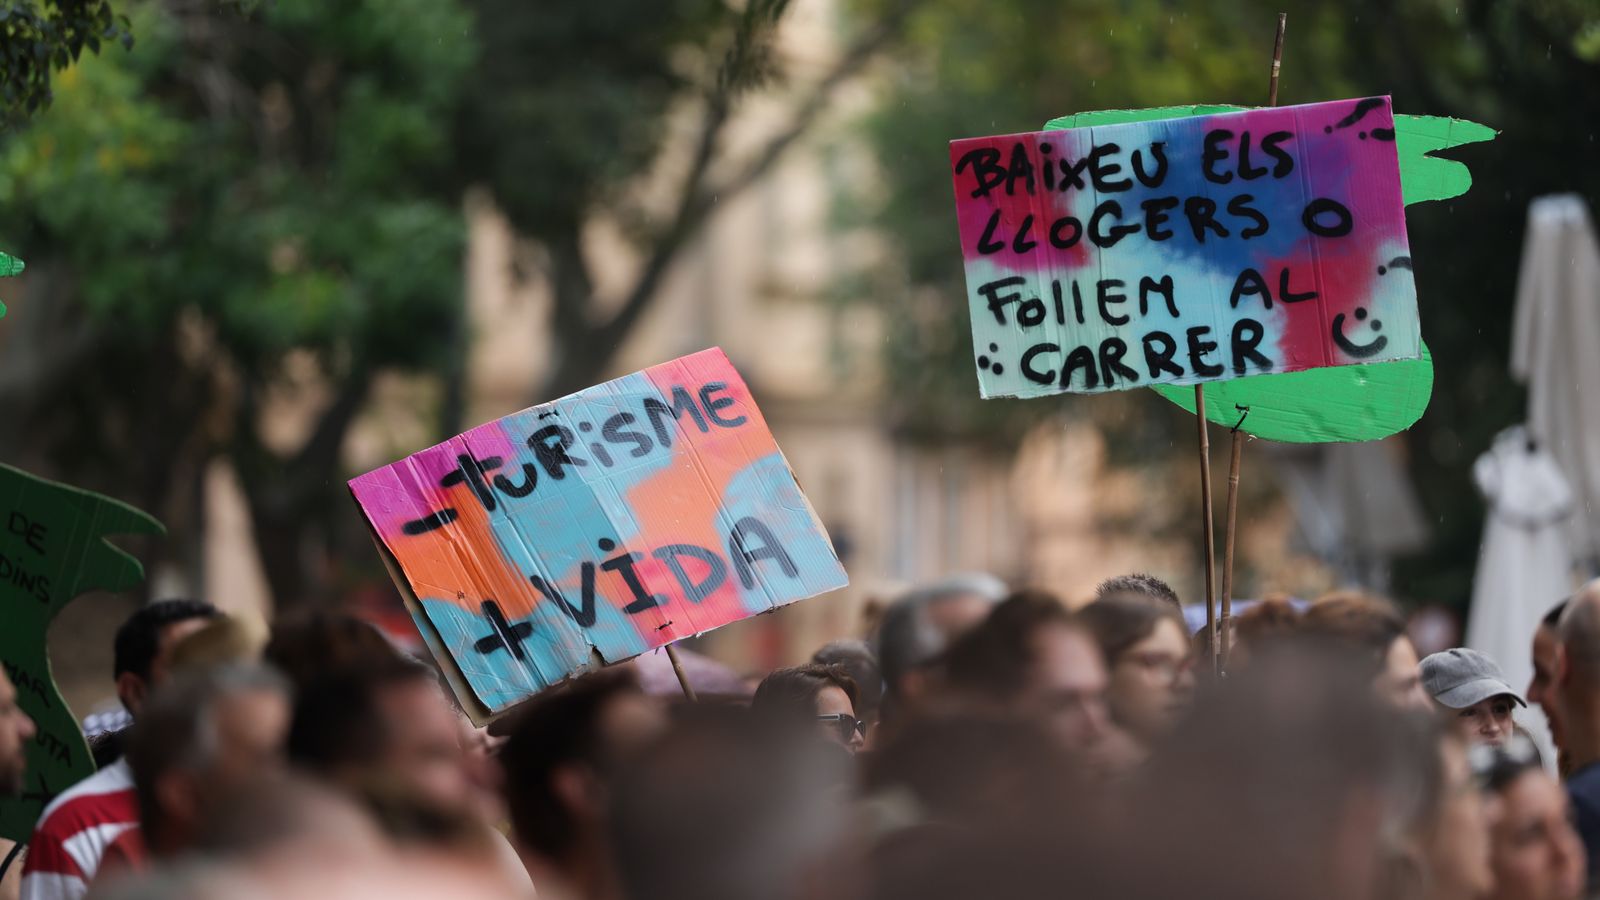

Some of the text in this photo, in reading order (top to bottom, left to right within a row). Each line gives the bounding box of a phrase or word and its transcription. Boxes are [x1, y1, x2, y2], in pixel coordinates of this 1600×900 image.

[1204, 129, 1294, 184] ELS
[978, 194, 1353, 254] LLOGERS O
[1230, 267, 1319, 309] AL
[1021, 319, 1273, 390] CARRER
[7, 510, 48, 556] DE
